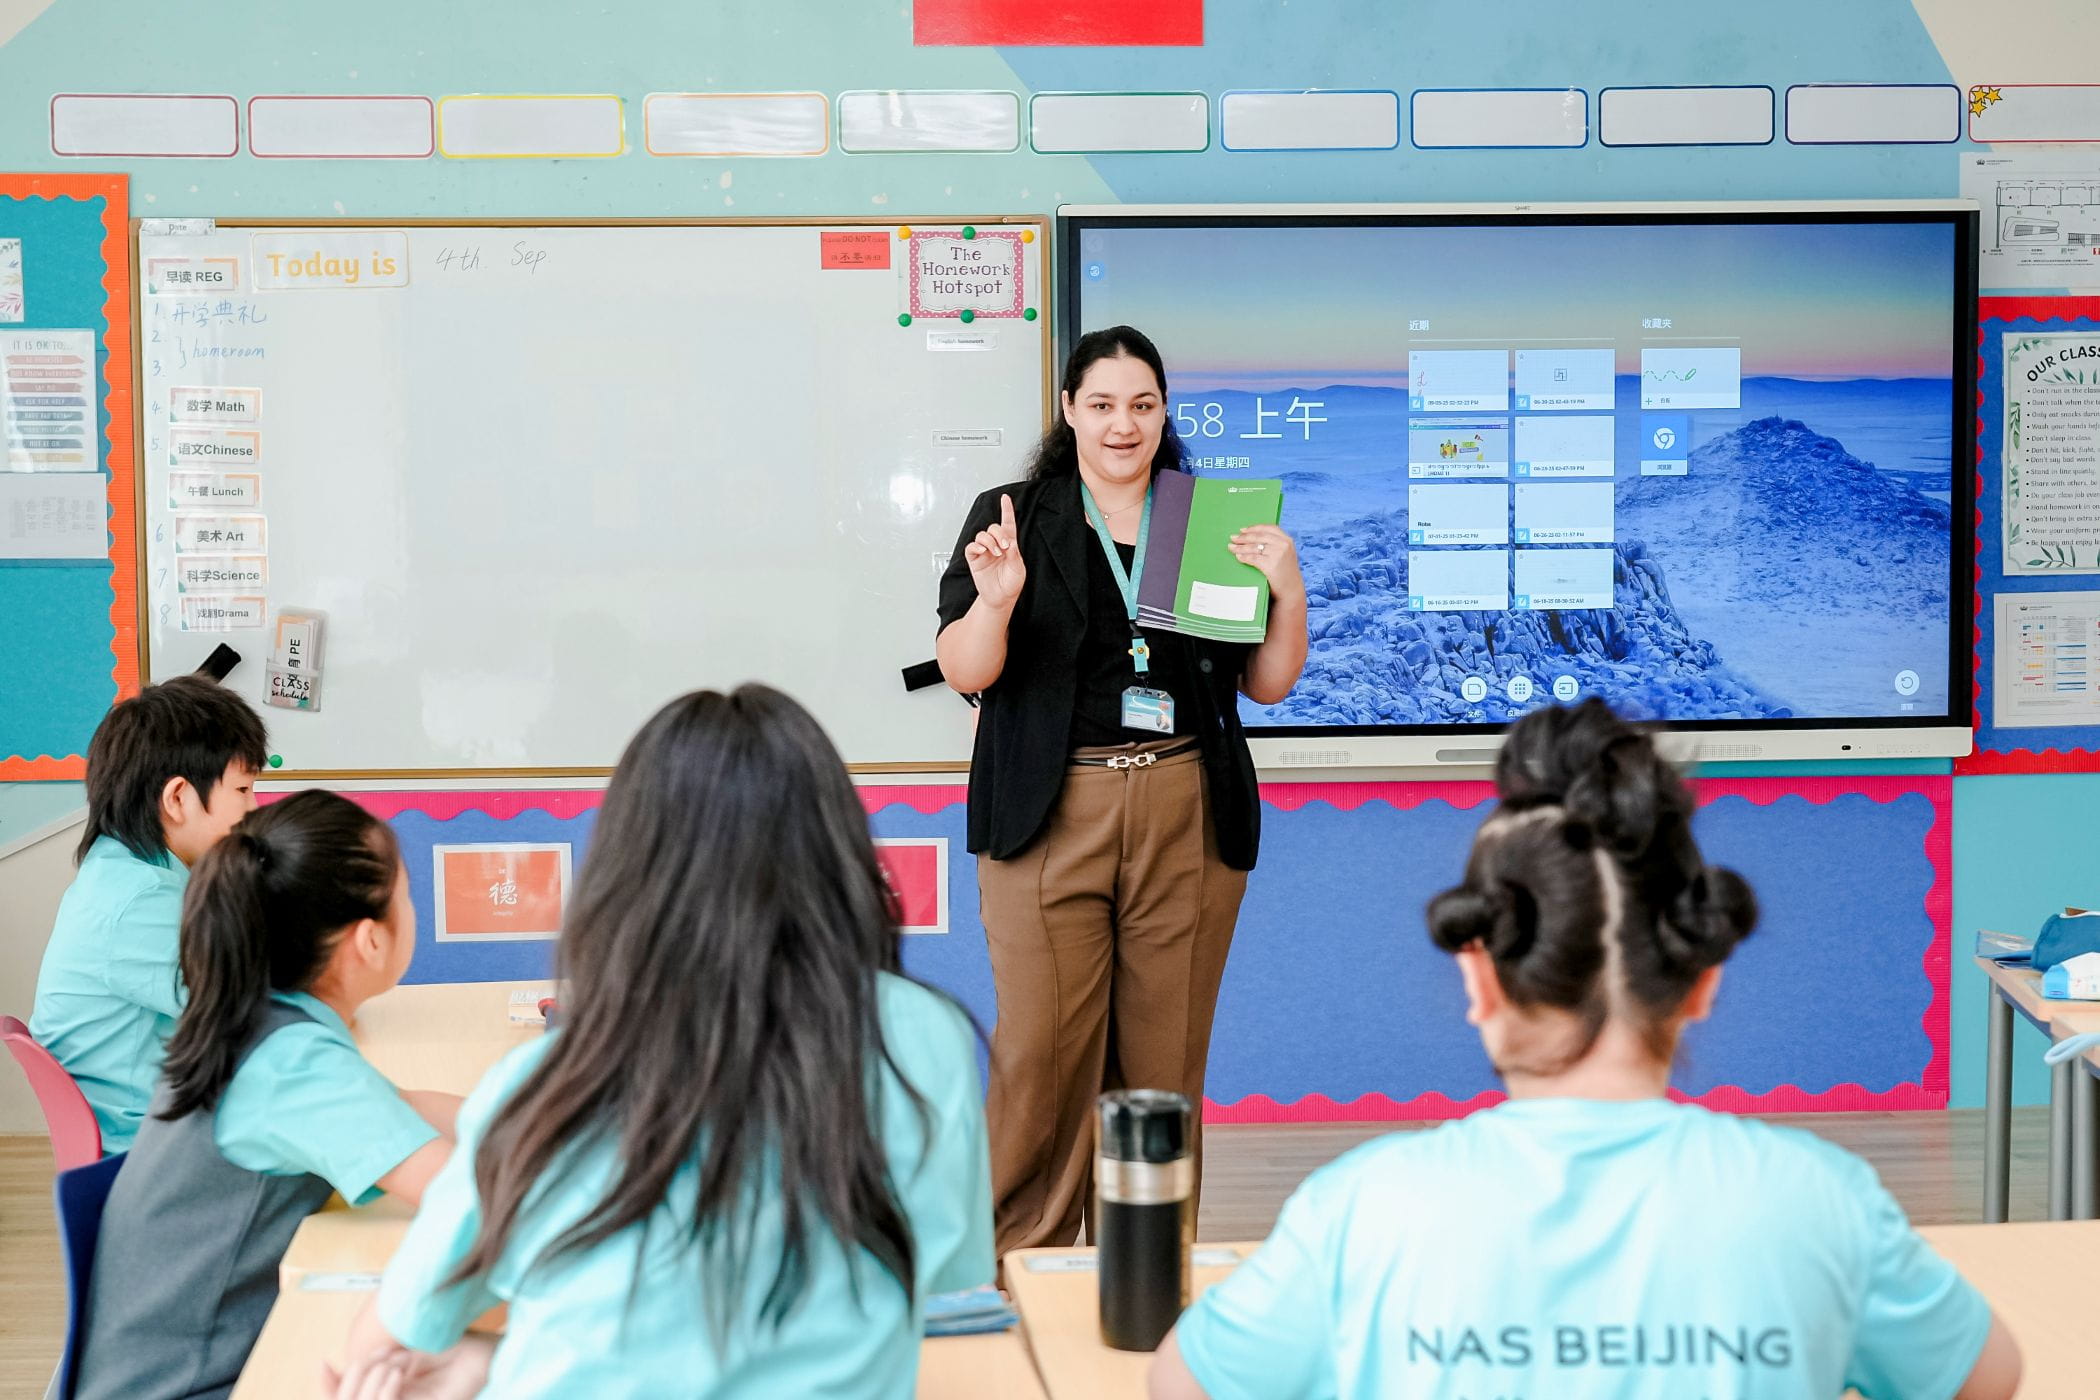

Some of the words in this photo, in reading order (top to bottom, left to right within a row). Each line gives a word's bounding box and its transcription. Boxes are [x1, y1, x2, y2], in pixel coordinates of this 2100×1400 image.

[511, 240, 547, 275] Sep
[951, 246, 982, 261] The
[266, 252, 359, 284] Today
[372, 251, 397, 275] is
[922, 262, 1011, 276] Homework
[166, 271, 192, 283] 早读
[195, 272, 223, 282] REG
[932, 279, 1003, 297] Hotspot
[172, 300, 267, 327] 开学典礼
[1409, 320, 1430, 331] 近期
[193, 337, 265, 358] homeroom
[2027, 356, 2057, 382] OUR
[187, 400, 212, 412] 数学
[216, 402, 245, 412] Math
[1239, 396, 1328, 440] 上午
[212, 487, 244, 496] Lunch
[197, 530, 222, 543] 美术
[226, 531, 244, 542] Art
[290, 639, 301, 655] PE
[273, 676, 310, 691] CLASS
[489, 879, 518, 906] 德
[1408, 1325, 1533, 1367] NAS
[1555, 1324, 1792, 1367] BEIJING
